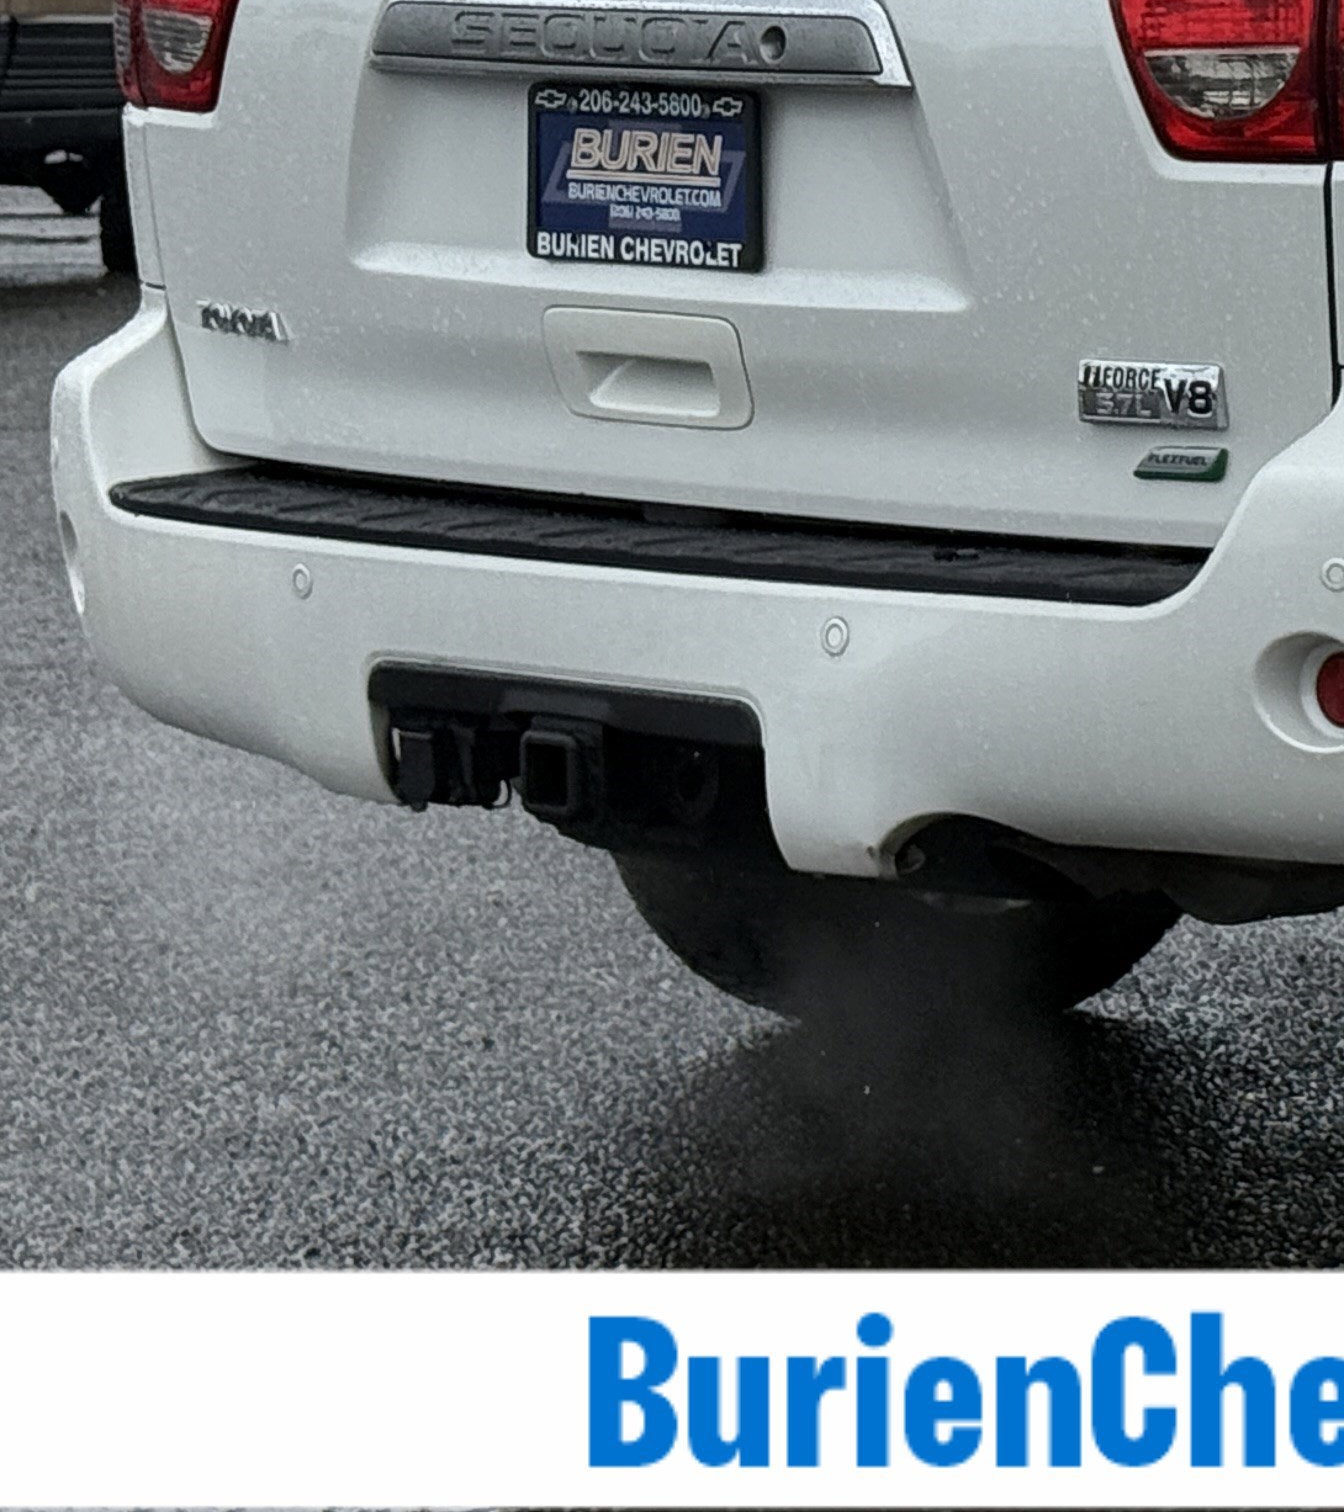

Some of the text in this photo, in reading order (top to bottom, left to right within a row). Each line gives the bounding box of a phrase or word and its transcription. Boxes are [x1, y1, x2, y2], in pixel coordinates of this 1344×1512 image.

[451, 10, 759, 64] SEQUOIA
[579, 89, 702, 117] 206-243-5800
[570, 128, 723, 176] BURIEN
[568, 182, 722, 208] BURIENCHEVROLET.COM
[537, 231, 742, 268] BURIEN CHEVROLET
[1164, 379, 1213, 417] V8
